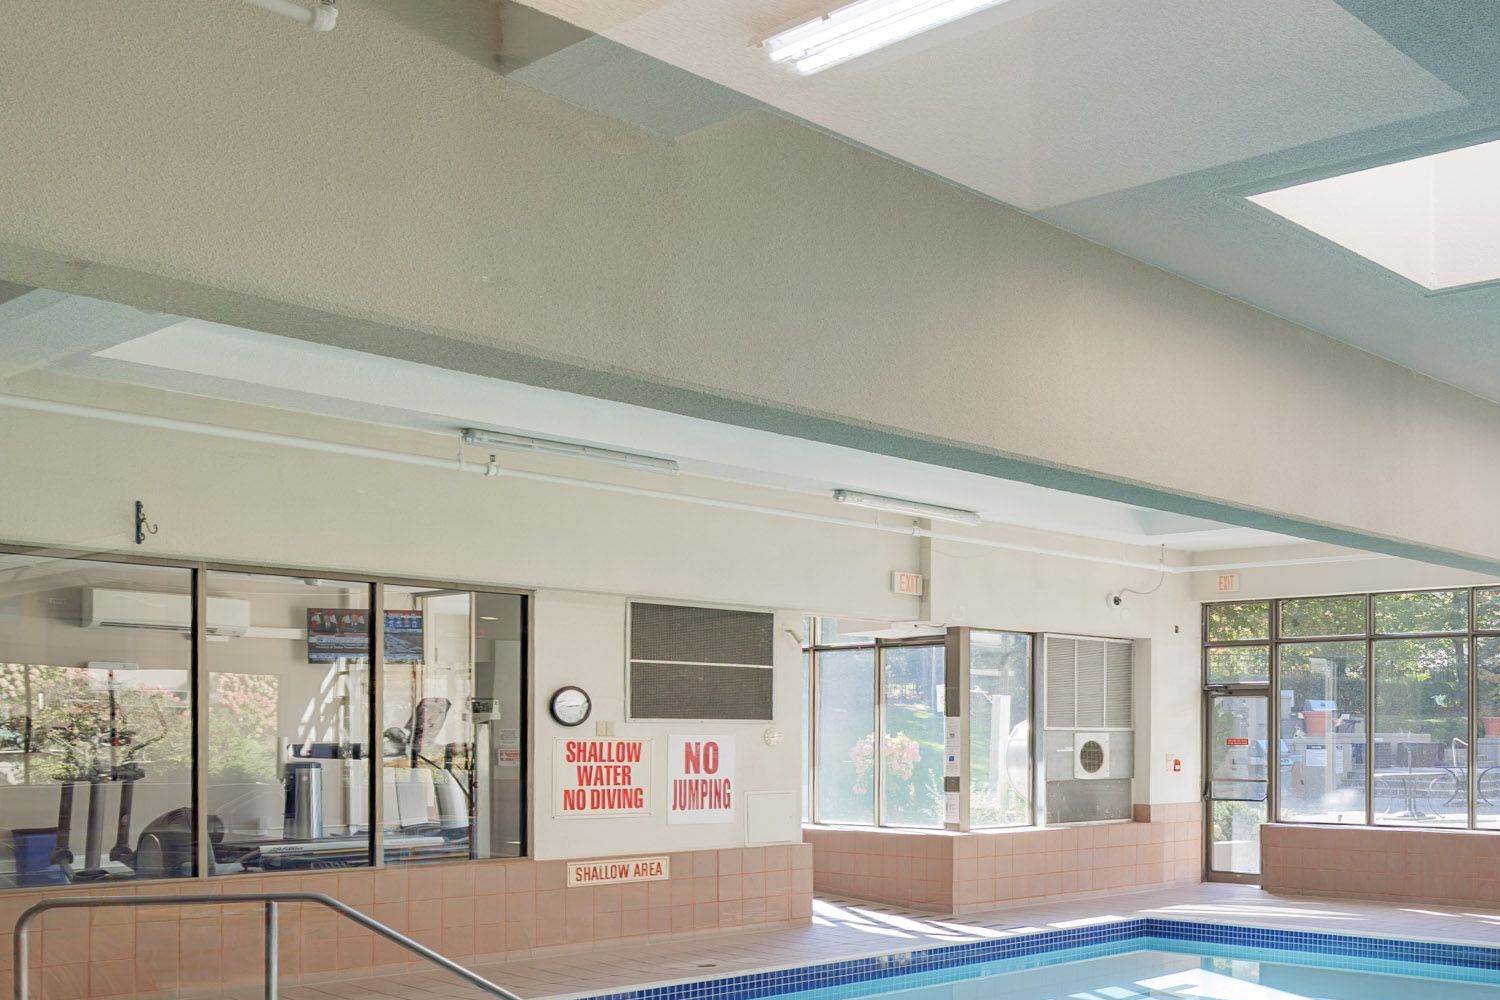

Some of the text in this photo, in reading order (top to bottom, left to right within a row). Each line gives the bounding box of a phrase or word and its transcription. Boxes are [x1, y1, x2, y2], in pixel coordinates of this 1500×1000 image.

[899, 574, 919, 593] EXIT
[1218, 575, 1233, 591] EXIT
[565, 741, 642, 763] SHALLOW
[684, 741, 719, 775] NO
[577, 765, 631, 787] WATER
[563, 787, 643, 811] NO DIVING
[672, 778, 731, 811] JUMPING
[576, 862, 663, 882] SHALLOW AREA
